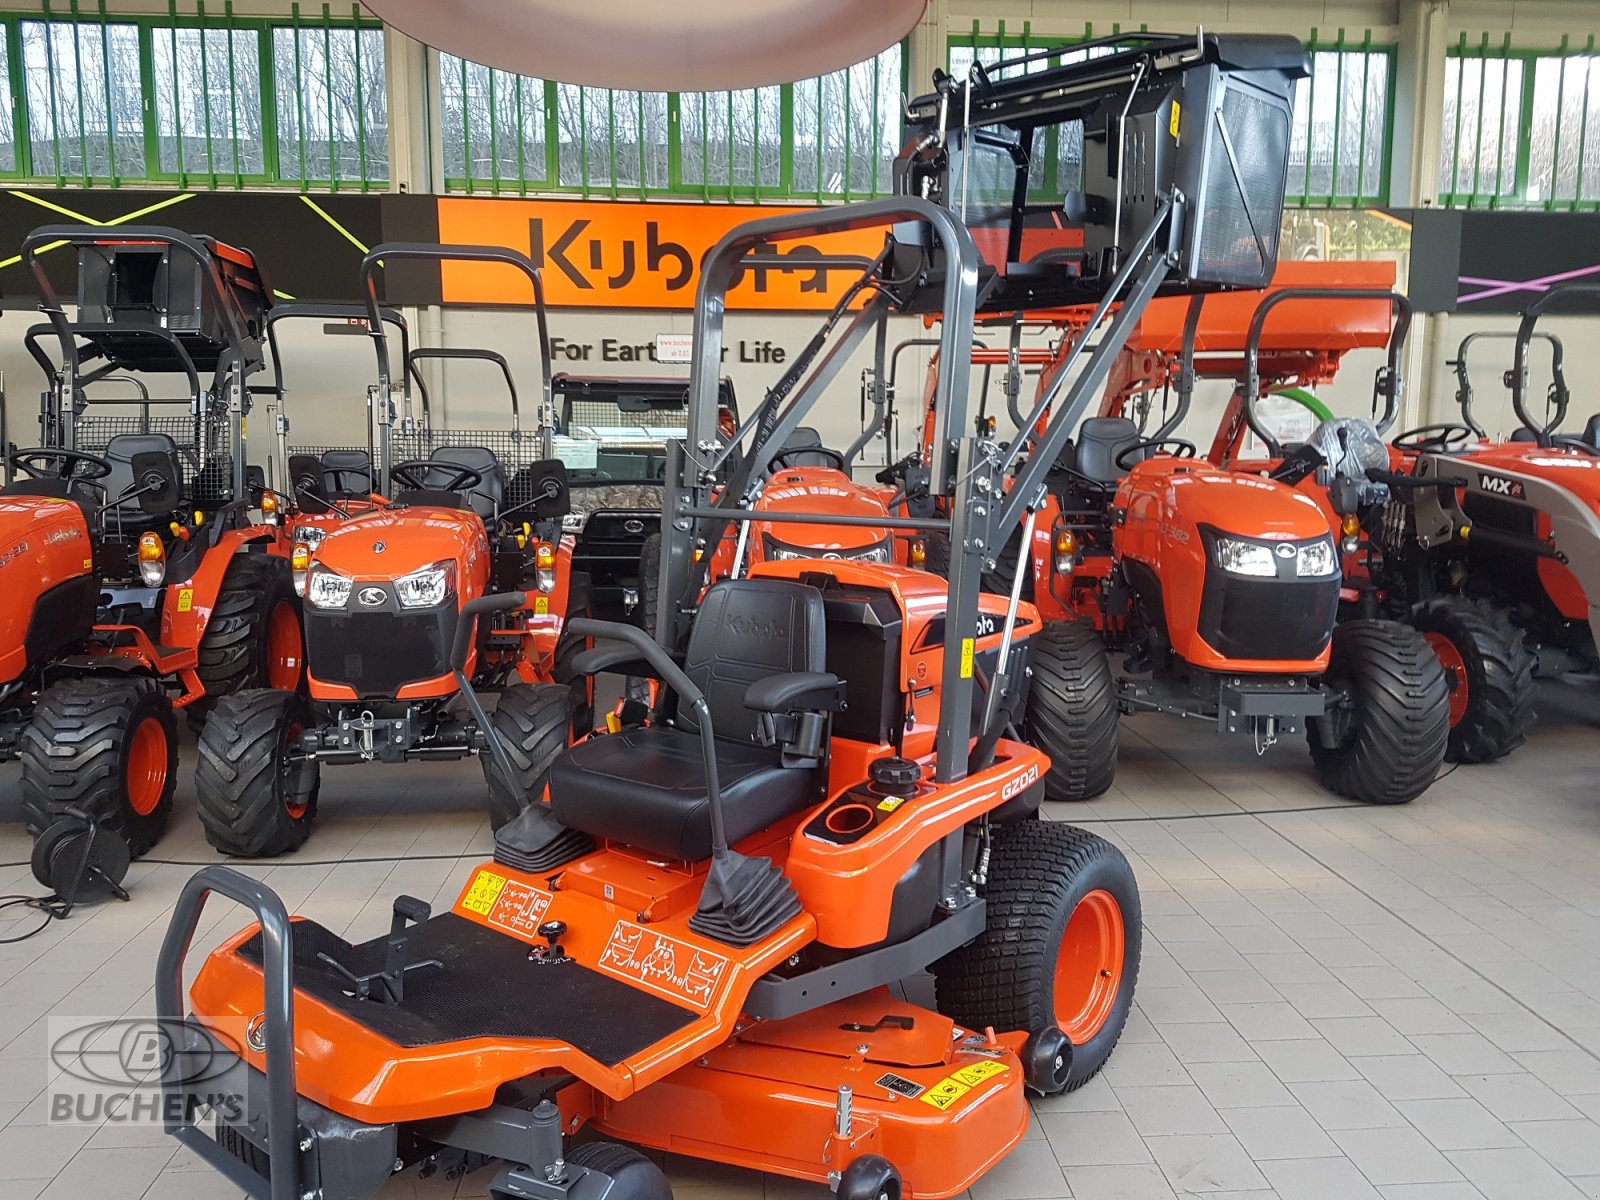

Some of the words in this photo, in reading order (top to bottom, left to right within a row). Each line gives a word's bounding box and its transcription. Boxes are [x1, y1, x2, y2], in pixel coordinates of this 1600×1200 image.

[550, 338, 593, 362] For
[602, 339, 657, 362] Eart
[739, 341, 786, 363] Life
[725, 612, 786, 641] Kubota
[976, 615, 995, 636] ota
[1002, 763, 1038, 800] GZD21
